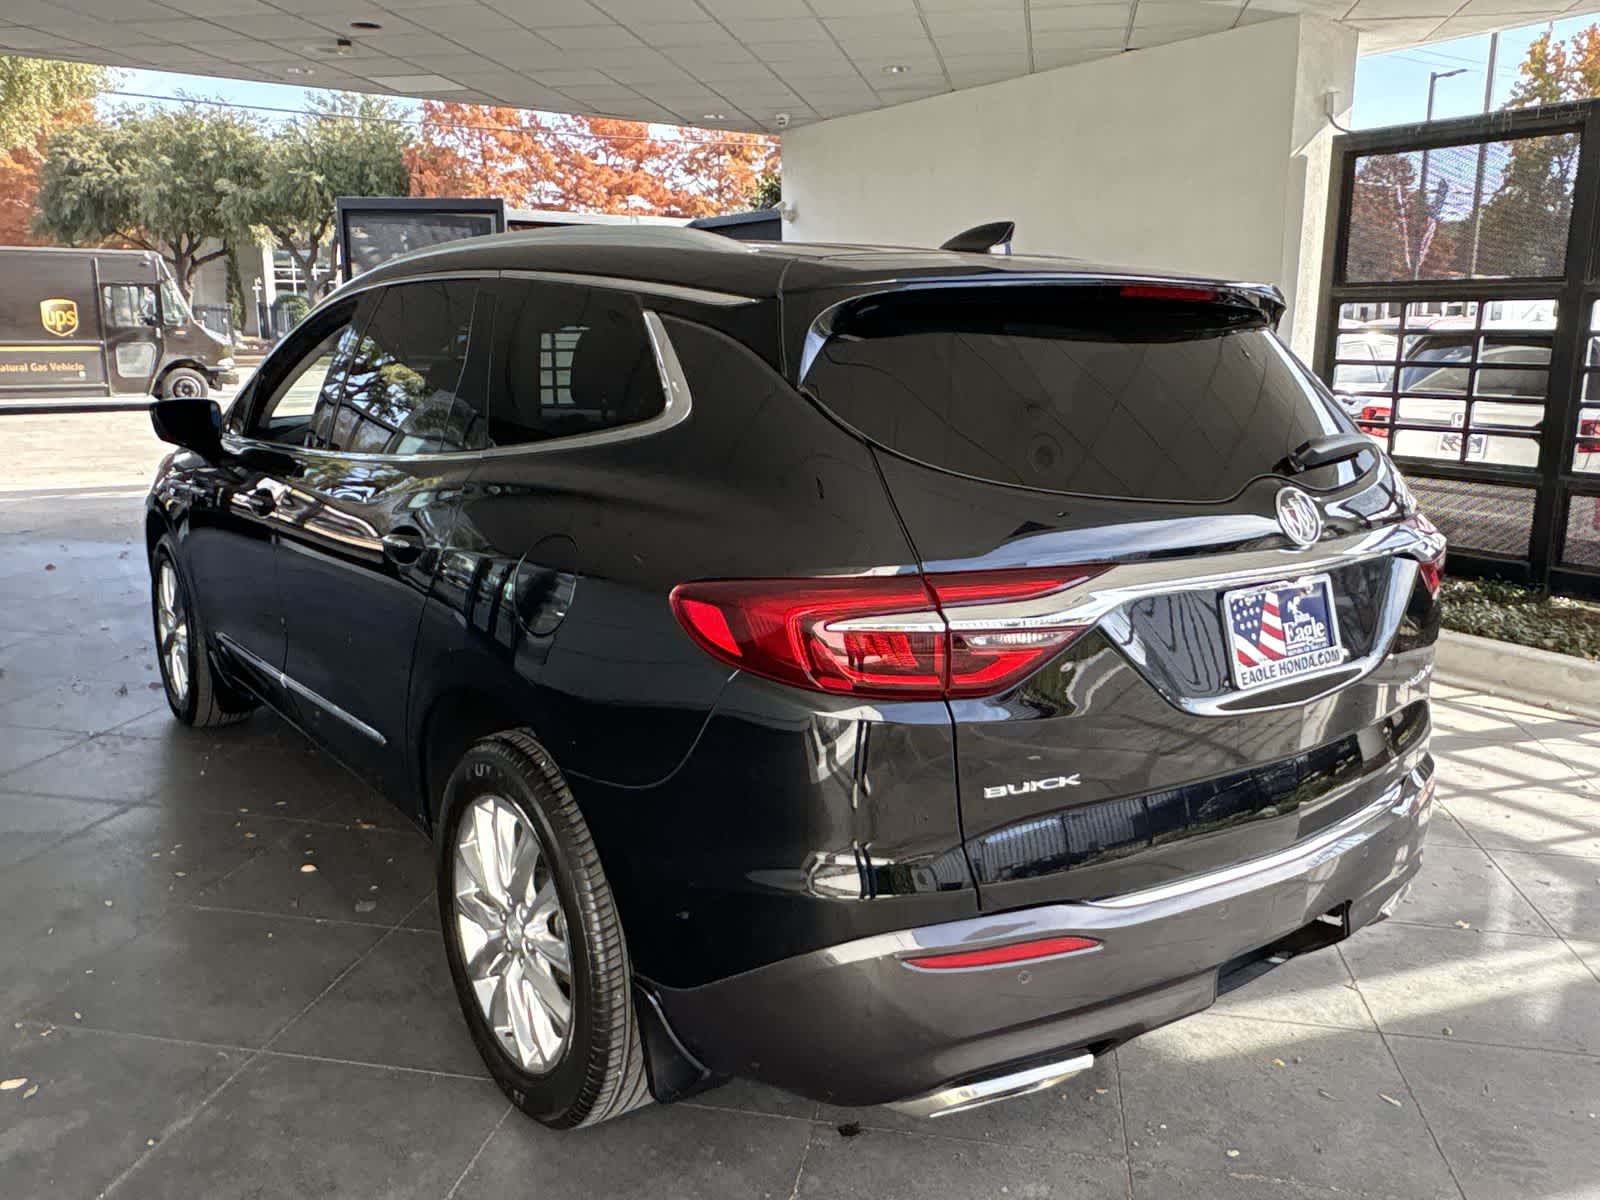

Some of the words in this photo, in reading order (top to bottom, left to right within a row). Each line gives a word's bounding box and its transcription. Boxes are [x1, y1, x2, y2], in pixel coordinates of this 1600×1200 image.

[46, 310, 76, 331] ups
[30, 362, 48, 372] Gas
[49, 361, 85, 371] Vehicle
[1282, 616, 1326, 646] Eagle
[1240, 664, 1277, 686] EAGLE
[1279, 648, 1341, 676] HONDA.COM
[984, 773, 1081, 799] BUICK
